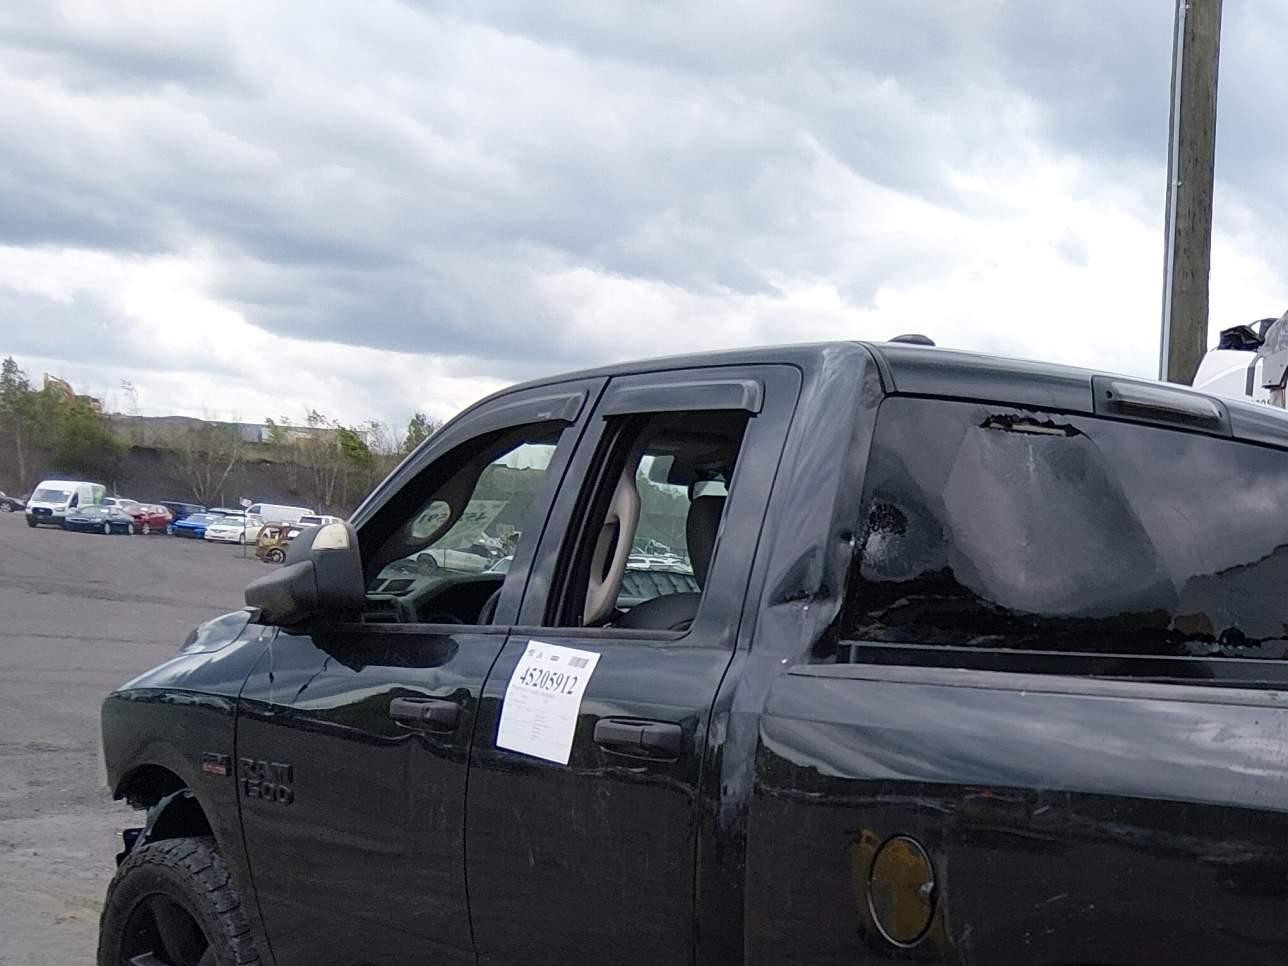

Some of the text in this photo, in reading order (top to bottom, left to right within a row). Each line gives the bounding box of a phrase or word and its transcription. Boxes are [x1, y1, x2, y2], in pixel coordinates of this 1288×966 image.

[519, 667, 578, 695] 45205912
[240, 757, 293, 785] RAM
[241, 778, 295, 805] 1500
